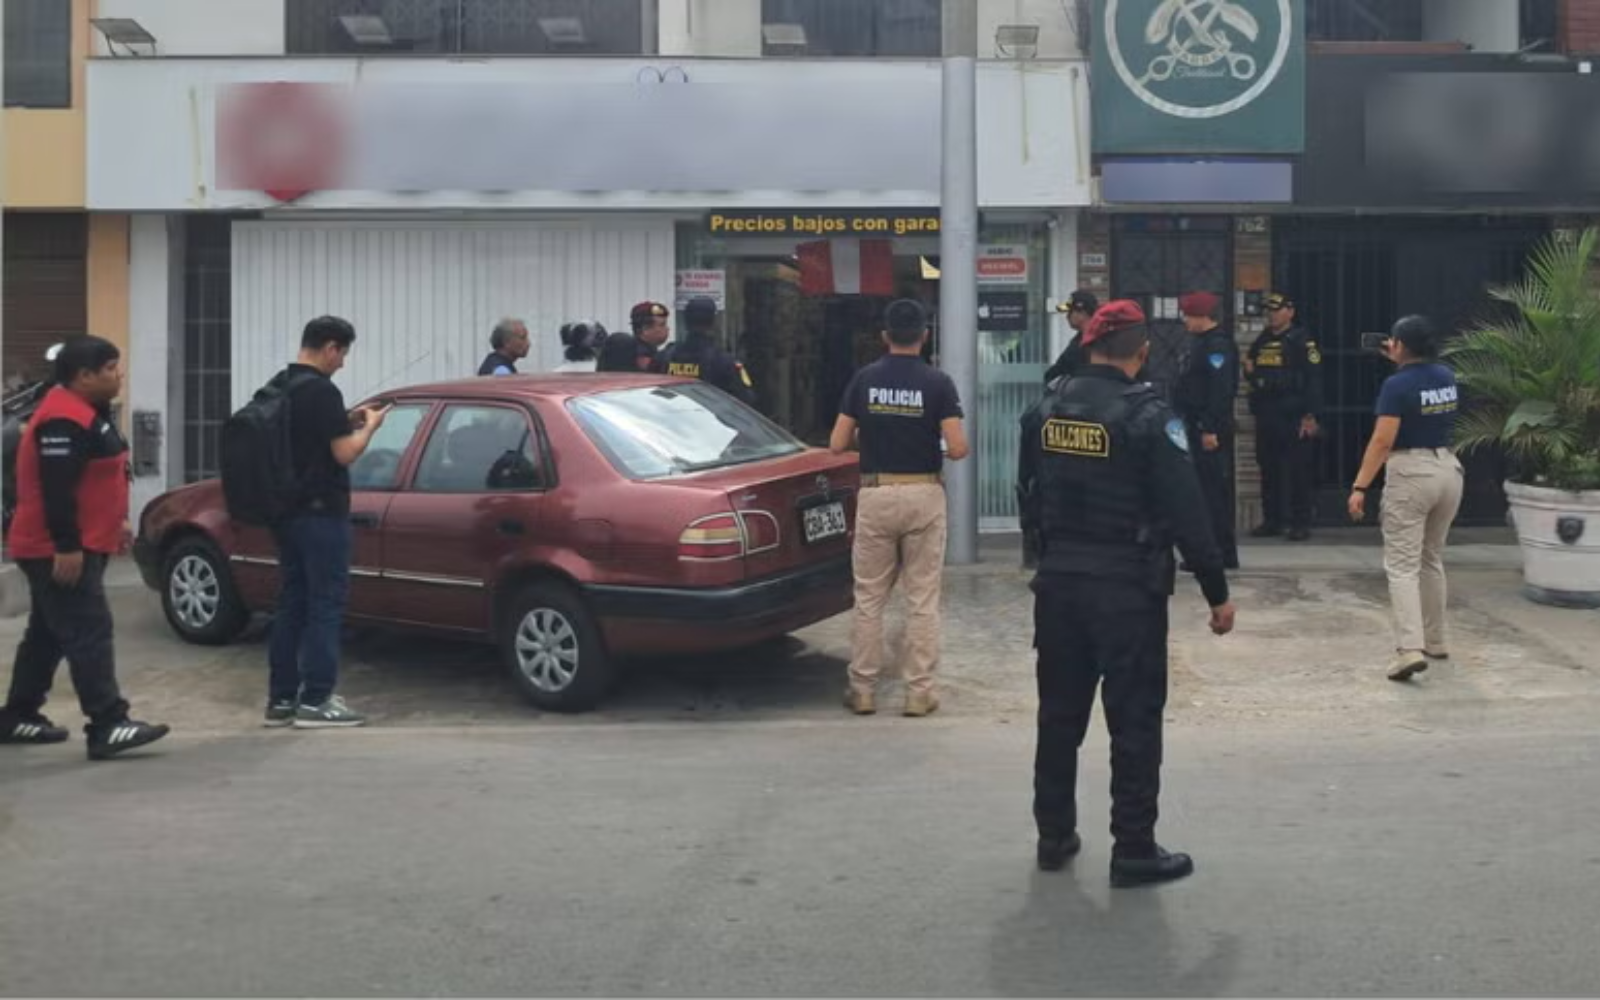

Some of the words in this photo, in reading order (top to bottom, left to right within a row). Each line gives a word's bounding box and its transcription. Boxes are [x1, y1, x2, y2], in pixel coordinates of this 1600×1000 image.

[710, 215, 786, 231] Precios
[793, 215, 846, 234] bajos
[852, 218, 889, 231] con
[894, 218, 942, 234] gara
[868, 387, 924, 408] POLICIA
[1046, 424, 1103, 451] HALCONES
